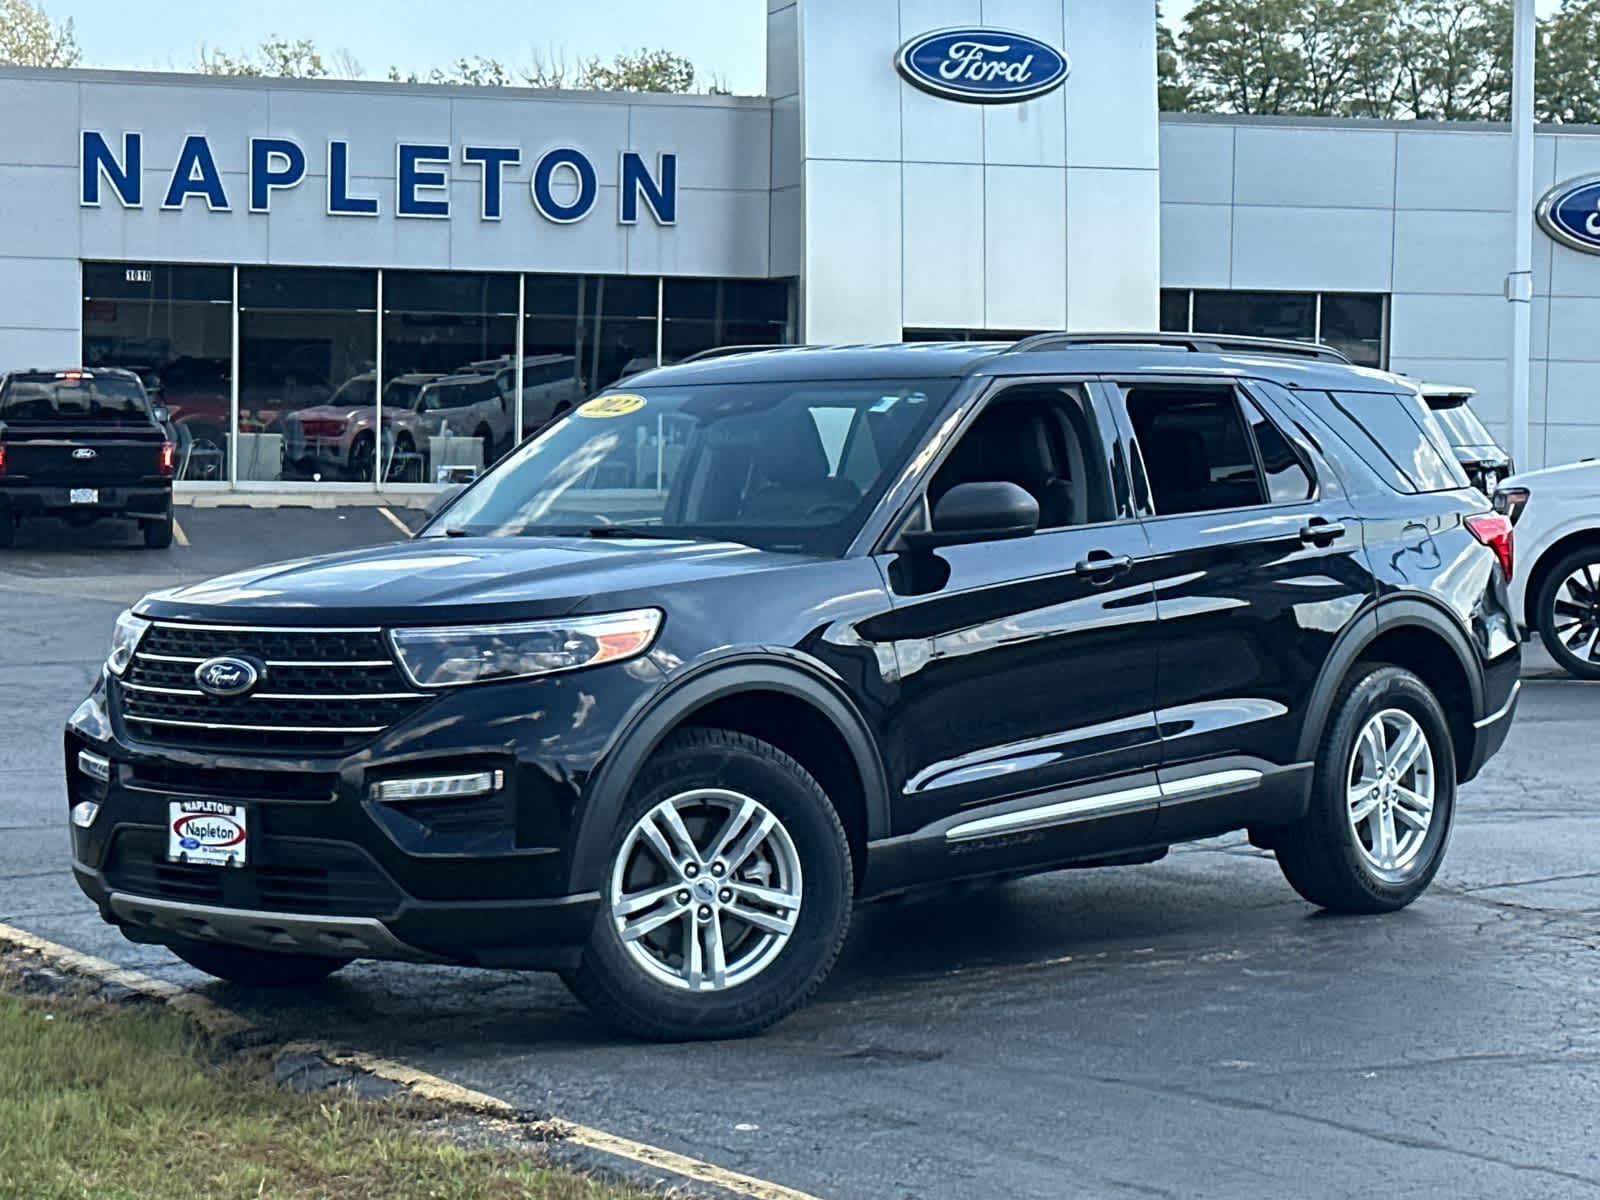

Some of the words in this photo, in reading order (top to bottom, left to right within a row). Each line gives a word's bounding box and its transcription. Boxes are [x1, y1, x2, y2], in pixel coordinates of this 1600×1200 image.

[939, 41, 1034, 83] Ford
[79, 129, 677, 226] NAPLETON
[126, 270, 152, 281] 1010
[206, 664, 241, 686] Ford
[184, 801, 233, 814] NAPLETON
[186, 821, 234, 840] Napleton
